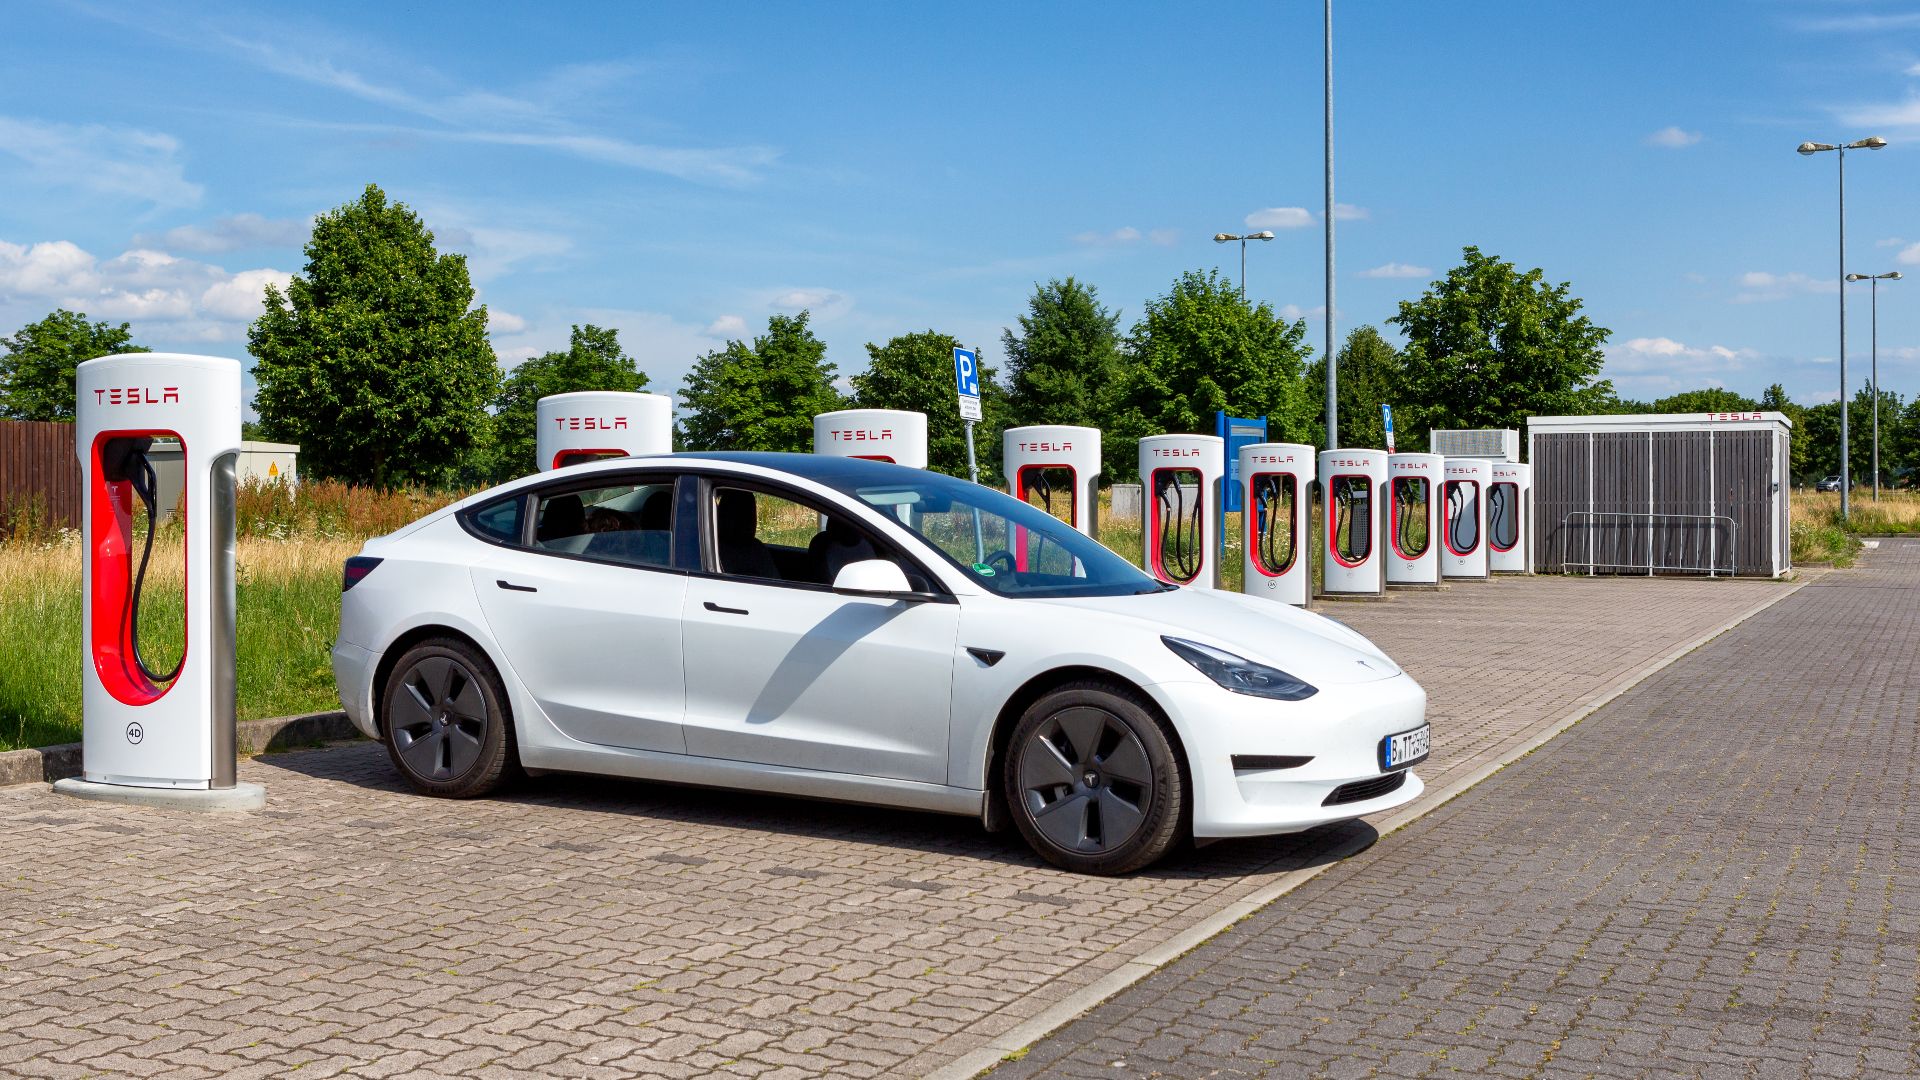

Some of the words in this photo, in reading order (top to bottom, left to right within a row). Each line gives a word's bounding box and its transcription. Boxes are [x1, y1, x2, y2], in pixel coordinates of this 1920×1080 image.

[959, 354, 973, 390] P
[94, 387, 178, 405] TESLA
[1707, 412, 1762, 421] TESLA
[555, 417, 627, 430] TESLA
[831, 430, 892, 440] TESLA
[1019, 443, 1072, 451] TESLA
[129, 729, 141, 737] 4D
[1393, 740, 1397, 761] B
